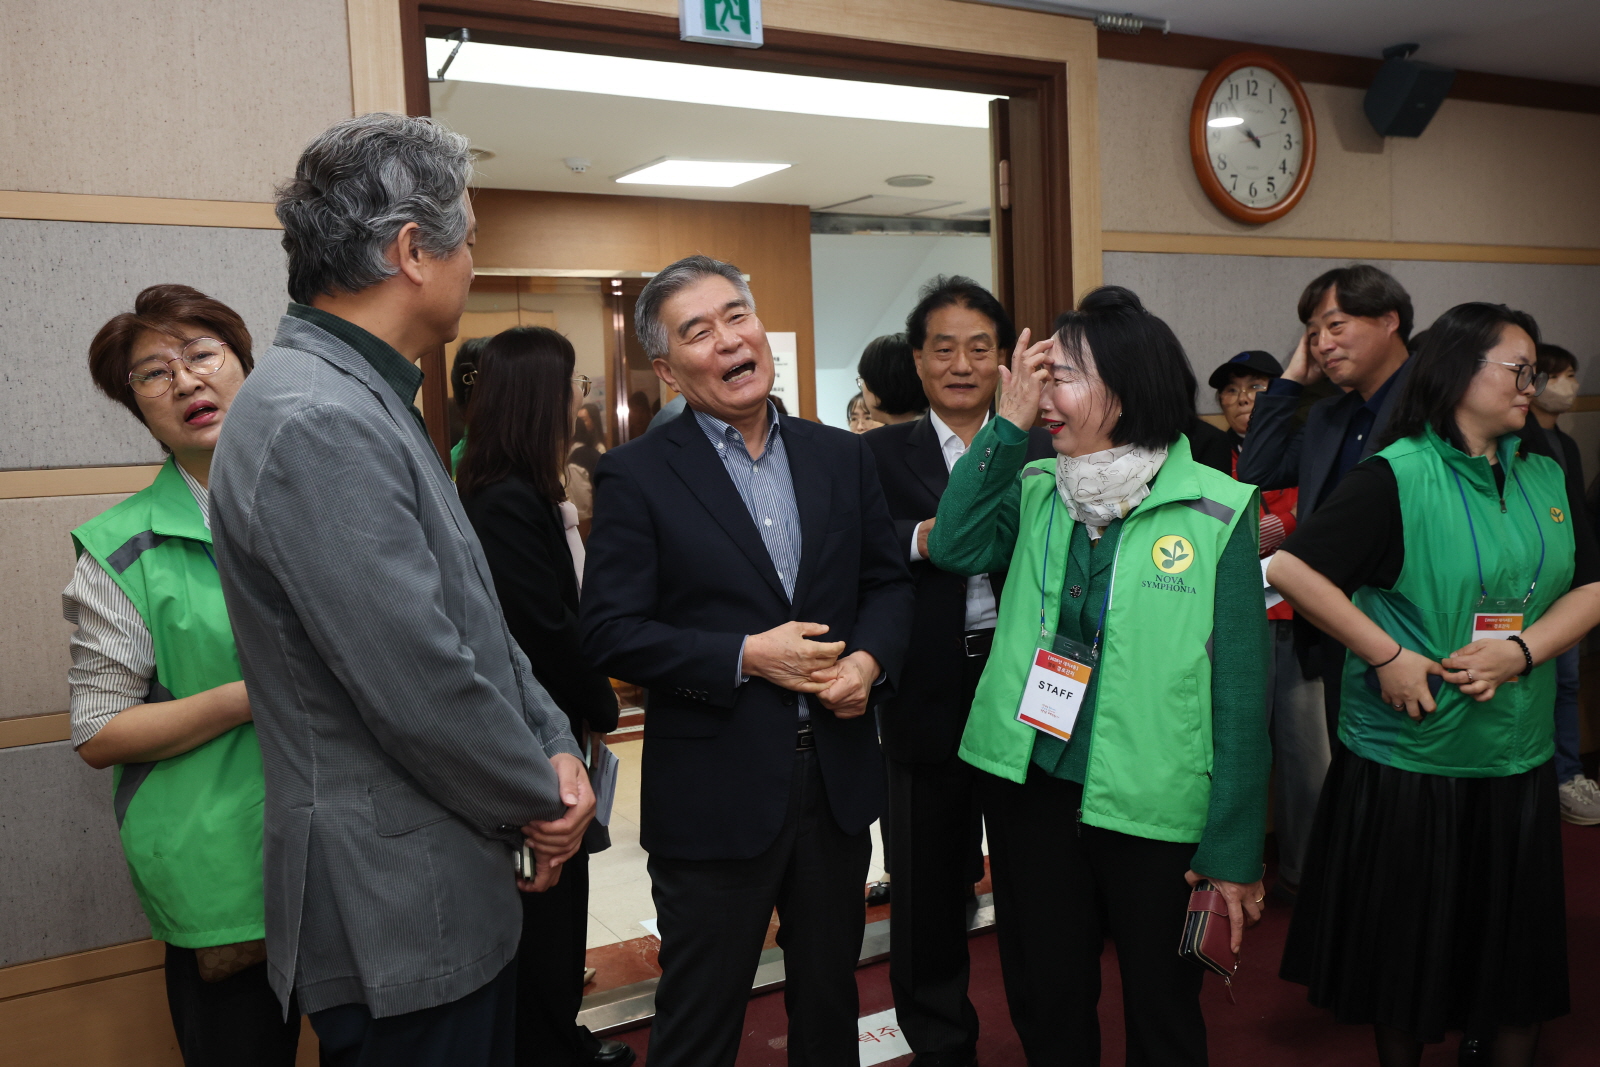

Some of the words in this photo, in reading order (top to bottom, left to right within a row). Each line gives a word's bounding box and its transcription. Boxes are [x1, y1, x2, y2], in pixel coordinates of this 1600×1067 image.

[1229, 84, 1239, 100] 11
[1247, 80, 1259, 96] 12
[1269, 88, 1273, 104] 1
[1215, 102, 1228, 117] 10
[1280, 108, 1287, 124] 2
[1284, 134, 1292, 150] 3
[1217, 153, 1227, 170] 8
[1279, 158, 1287, 174] 4
[1230, 174, 1238, 191] 7
[1249, 181, 1257, 198] 6
[1267, 176, 1275, 193] 5
[1141, 580, 1197, 594] SYMPHONIA
[1155, 574, 1185, 586] NOVA
[1038, 680, 1073, 699] STAFF
